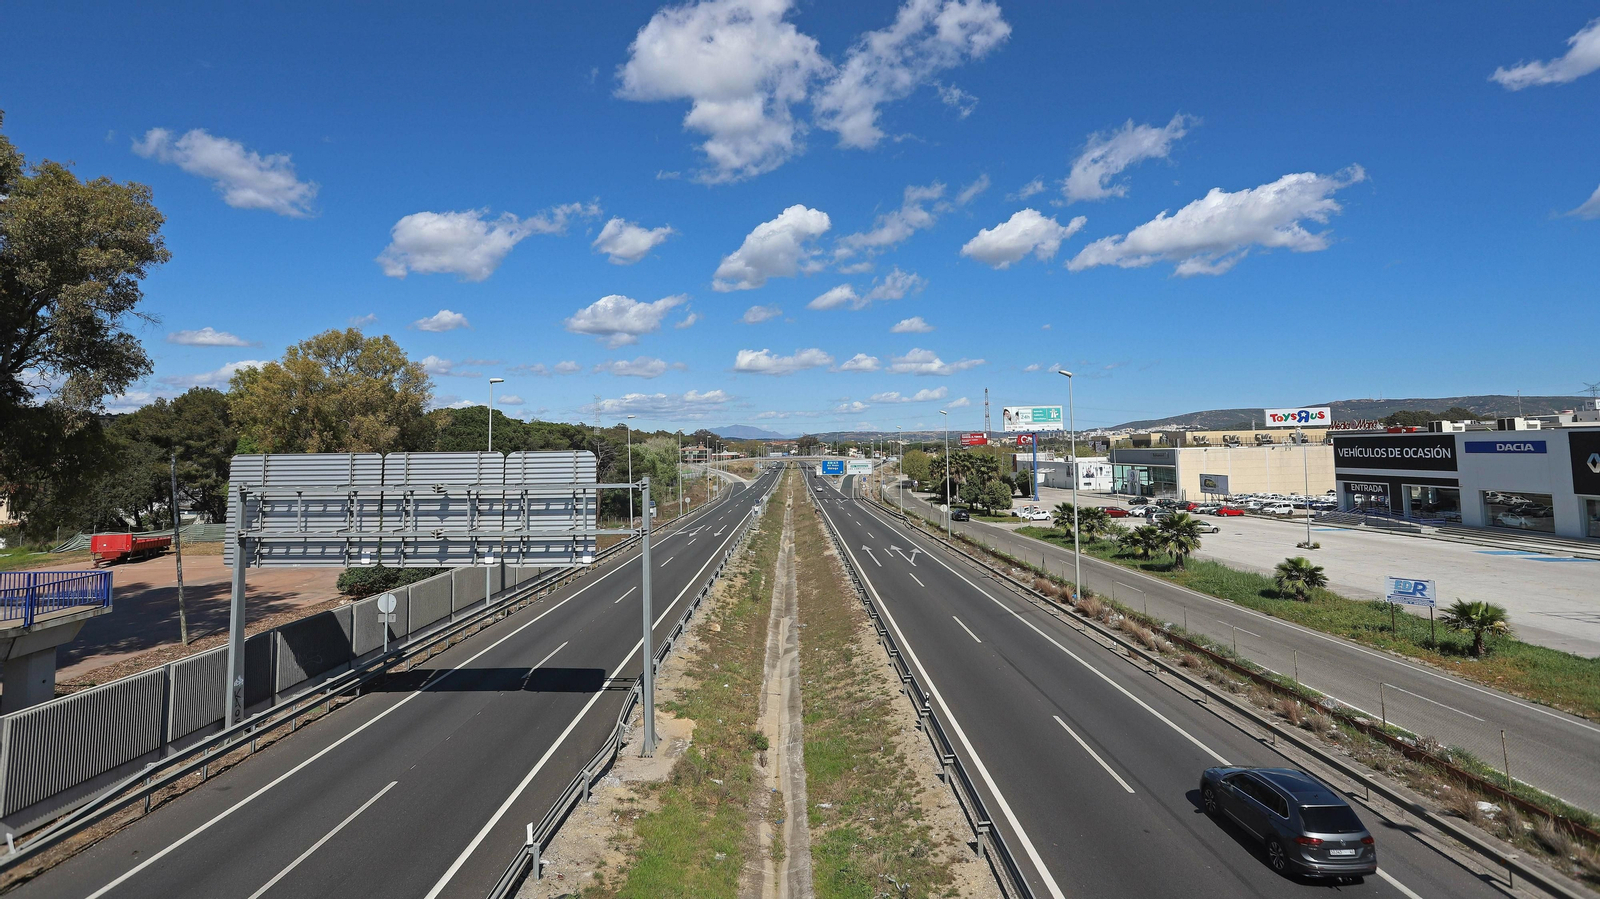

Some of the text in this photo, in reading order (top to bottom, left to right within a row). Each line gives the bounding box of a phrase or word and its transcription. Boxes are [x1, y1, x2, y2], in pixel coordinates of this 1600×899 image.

[1338, 444, 1451, 459] VEHÍCULOS DE OCASIÓN
[1496, 443, 1535, 452] DACIA
[1351, 483, 1384, 493] ENTRADA
[1394, 580, 1427, 597] EDR
